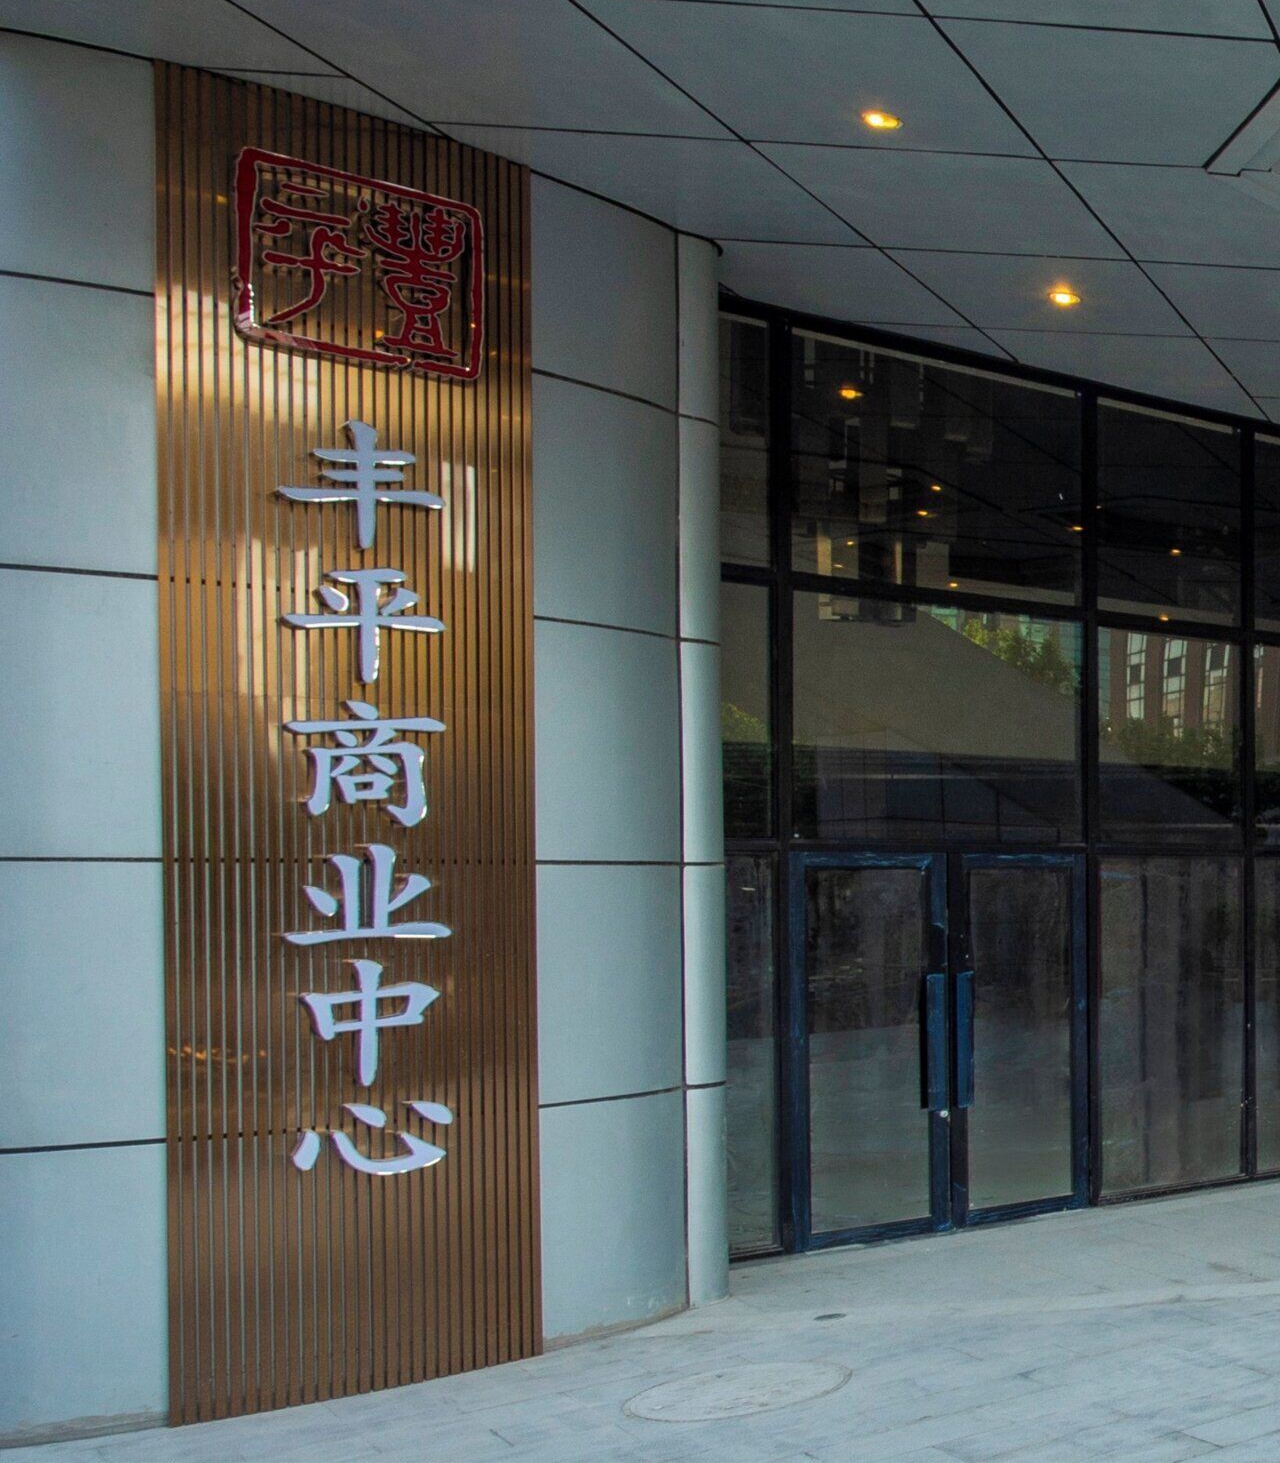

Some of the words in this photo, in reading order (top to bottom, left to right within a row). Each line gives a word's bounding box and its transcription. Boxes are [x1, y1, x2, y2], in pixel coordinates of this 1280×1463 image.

[274, 419, 453, 1176] 丰平商业中心
